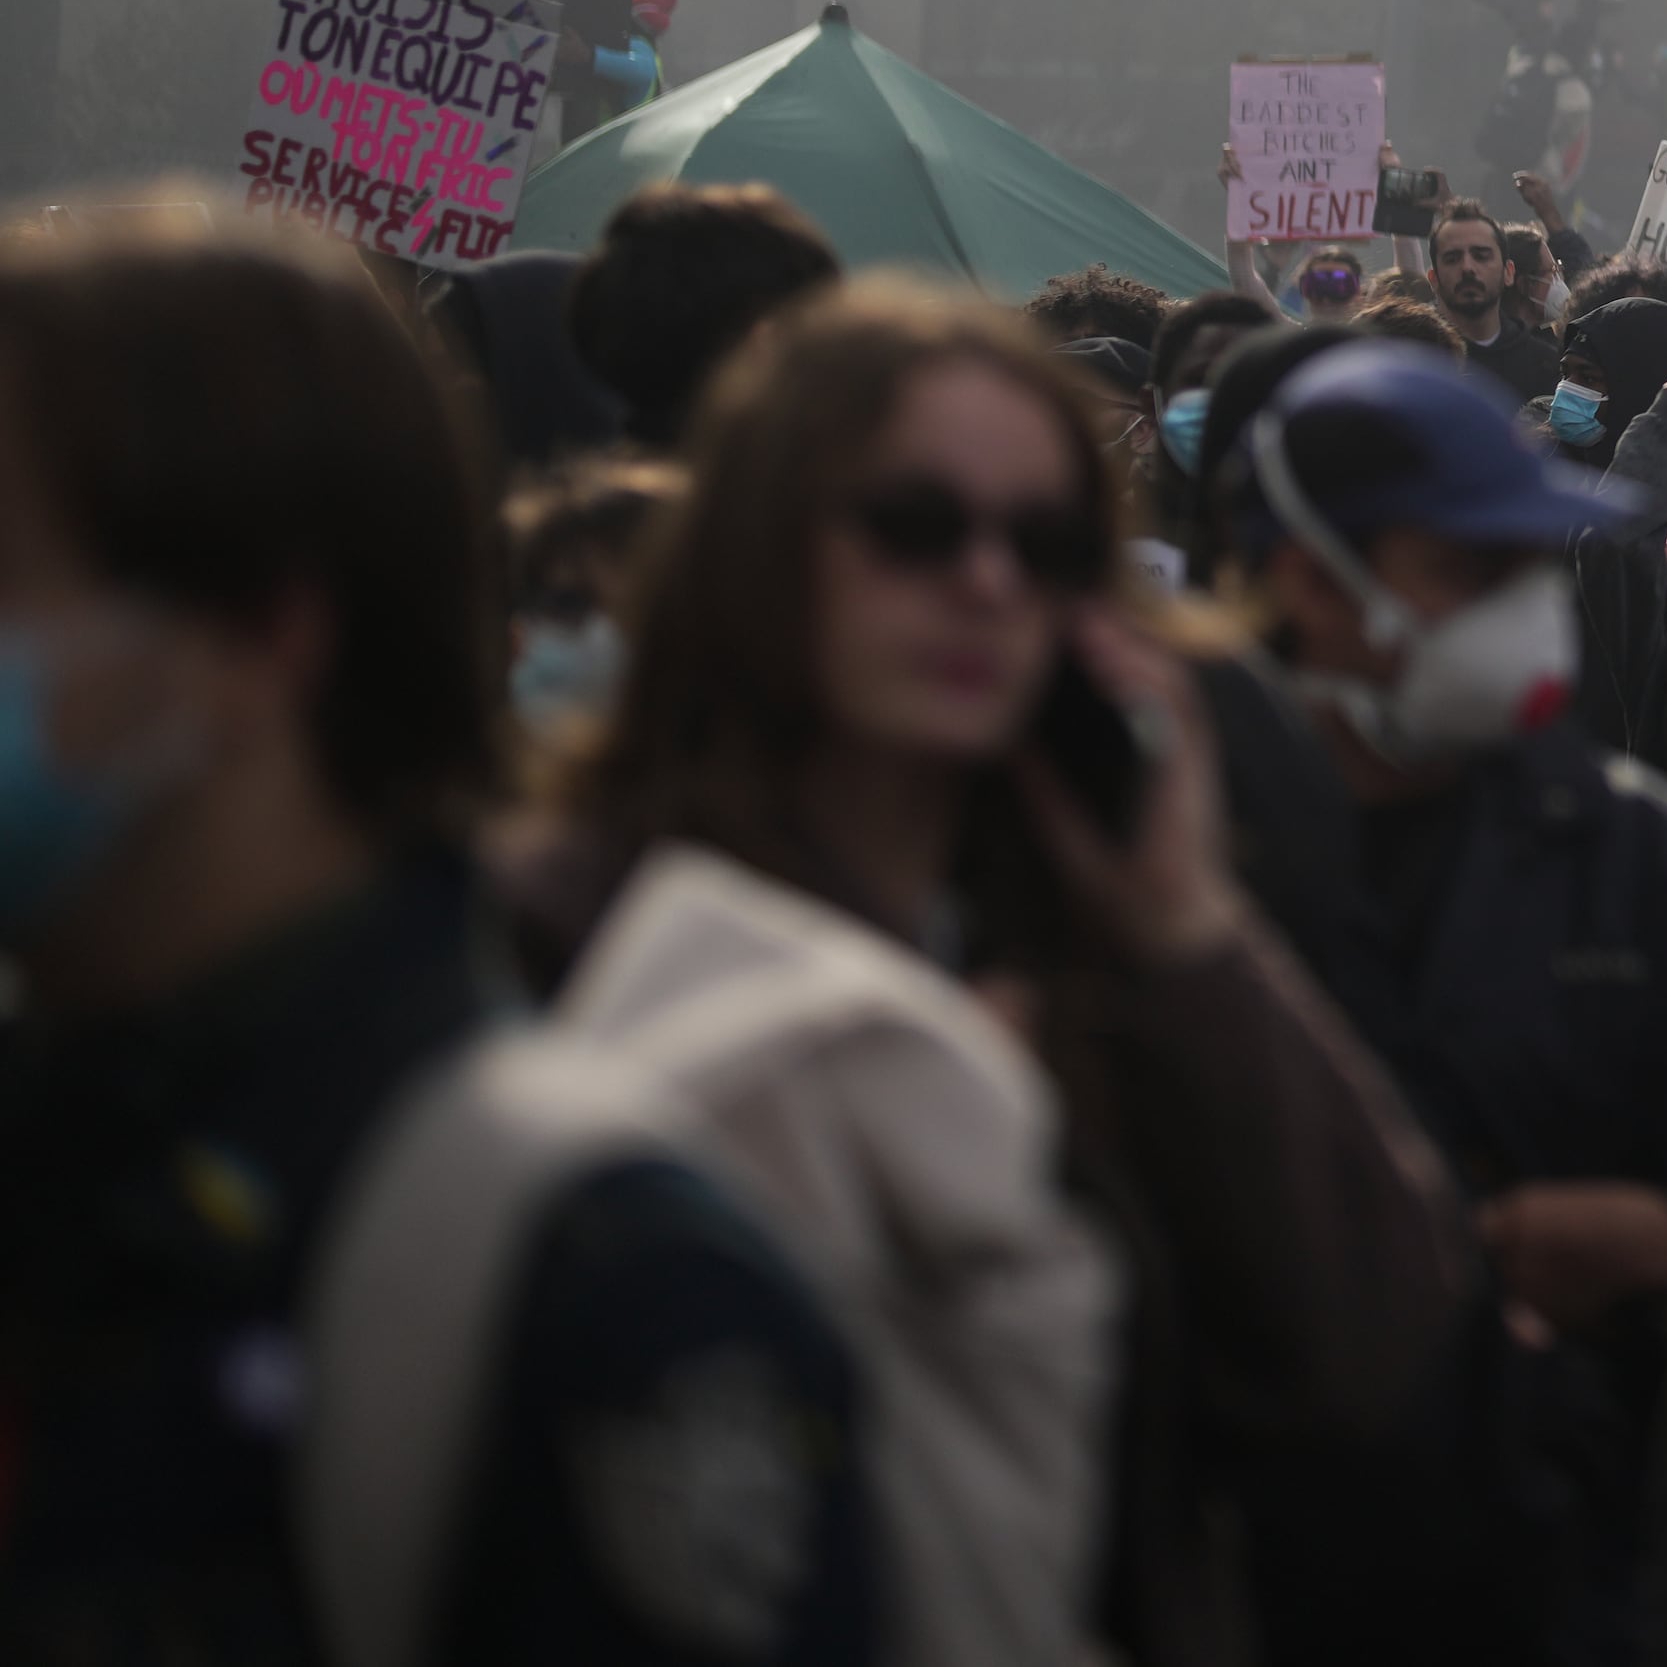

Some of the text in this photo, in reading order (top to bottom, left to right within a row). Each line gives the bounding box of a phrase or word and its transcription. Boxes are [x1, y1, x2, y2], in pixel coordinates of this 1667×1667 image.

[318, 75, 485, 166] METS-TU
[371, 28, 546, 131] EQUIPE
[1279, 70, 1322, 97] THE
[240, 130, 416, 226] SERVICE
[331, 122, 514, 212] TON FRIC
[244, 176, 406, 256] PUBLIC
[1249, 191, 1375, 238] SILENT
